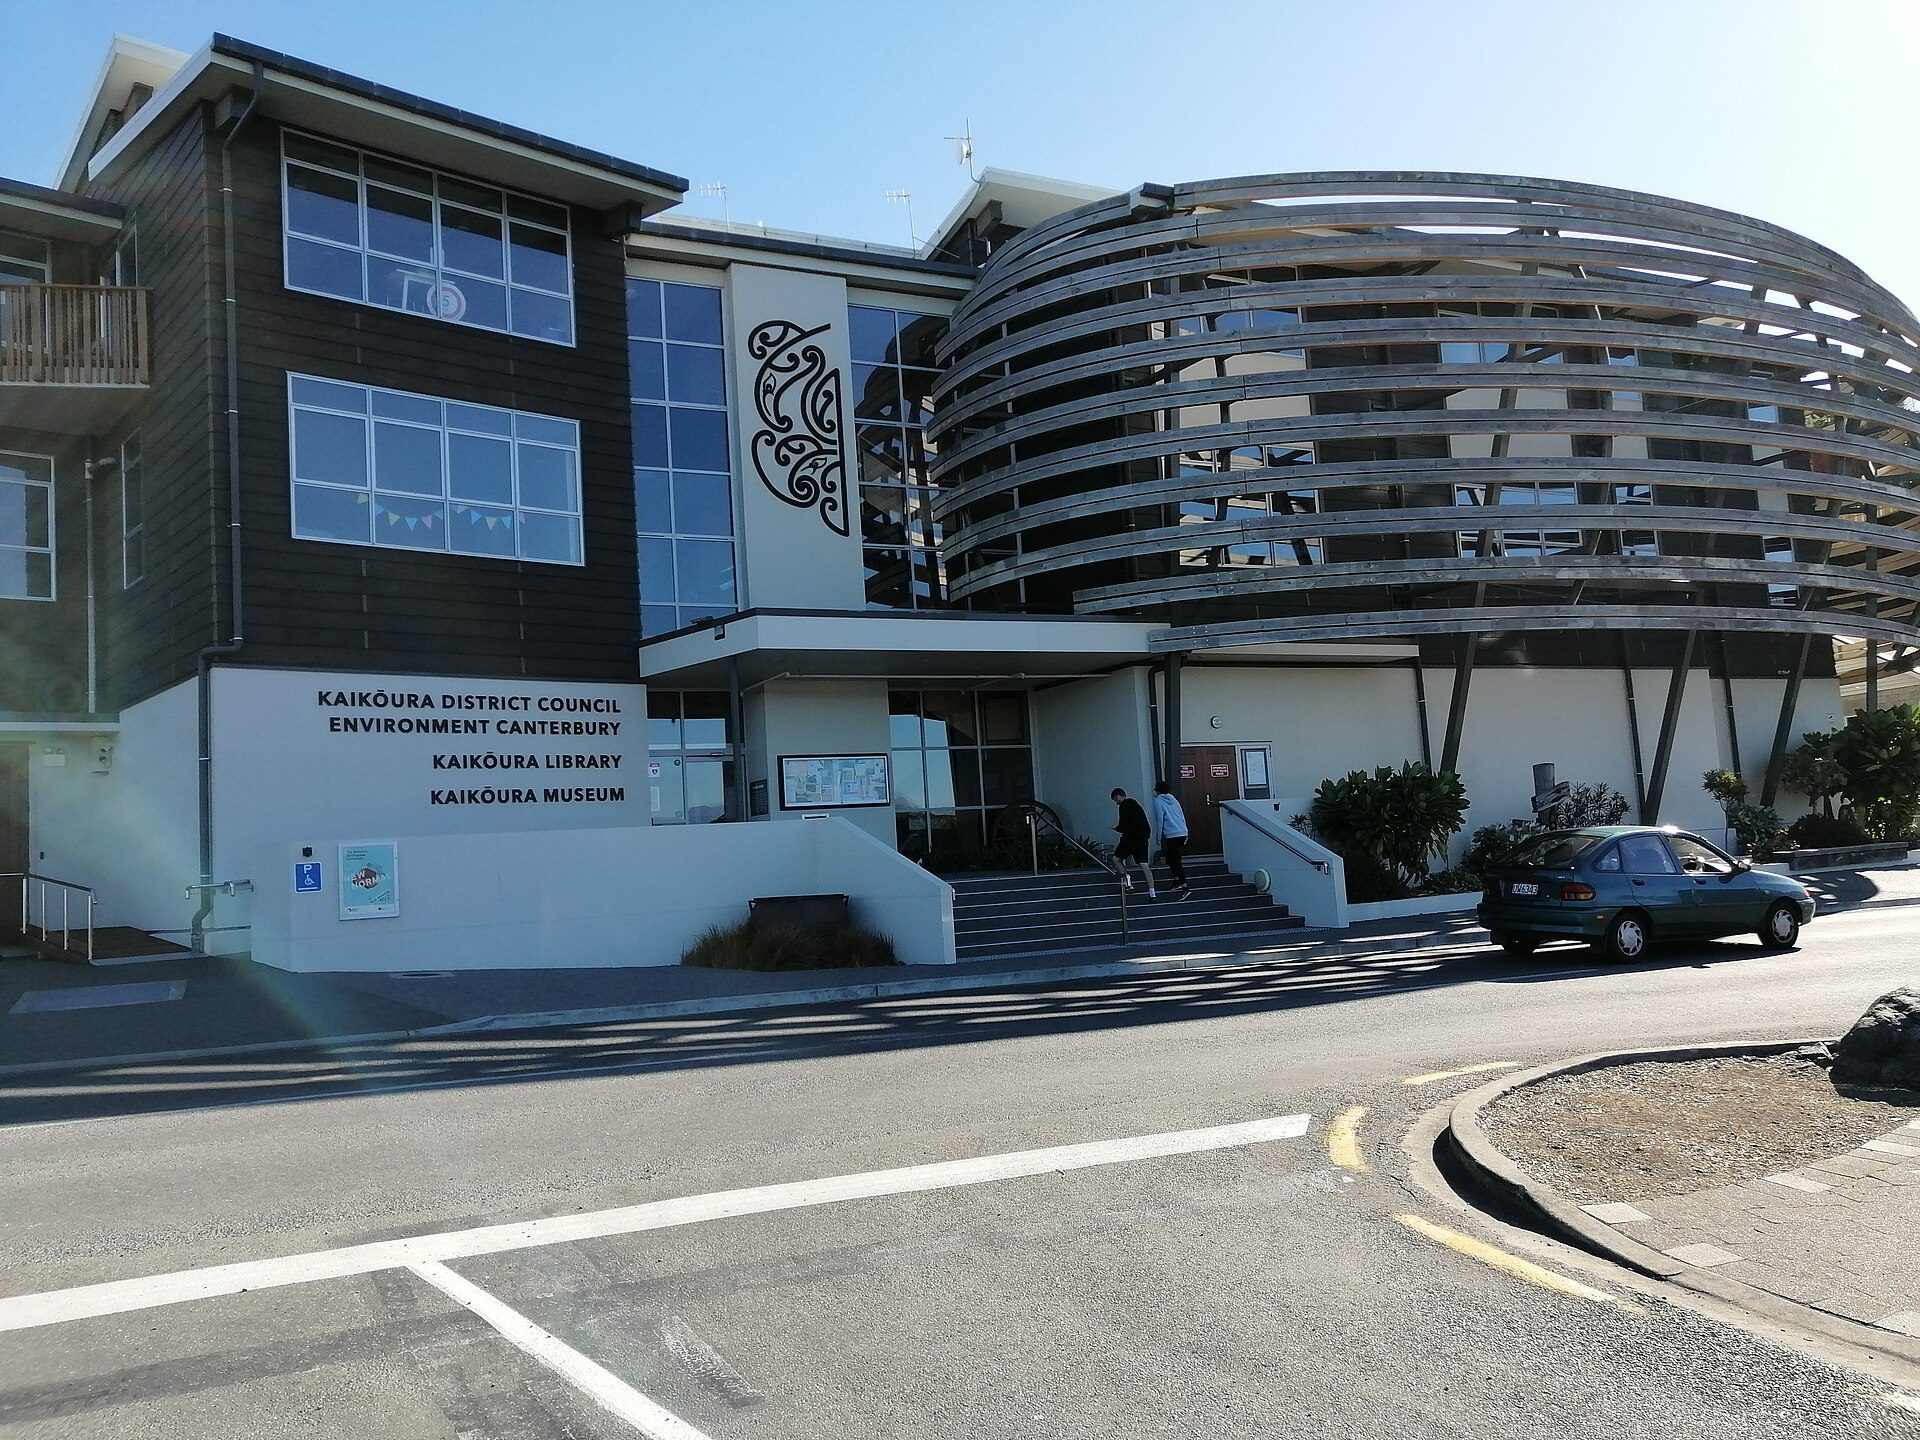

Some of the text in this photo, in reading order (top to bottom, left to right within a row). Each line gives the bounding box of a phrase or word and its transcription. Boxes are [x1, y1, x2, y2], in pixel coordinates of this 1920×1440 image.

[319, 690, 621, 713] KAIKŌURA DISTRICT COUNCIL
[330, 717, 620, 735] ENVIRONMENT CANTERBURY
[434, 752, 622, 769] KAIKŌURA LIBRARY
[431, 786, 624, 804] KAIKŌURA MUSEUM
[304, 864, 312, 874] P
